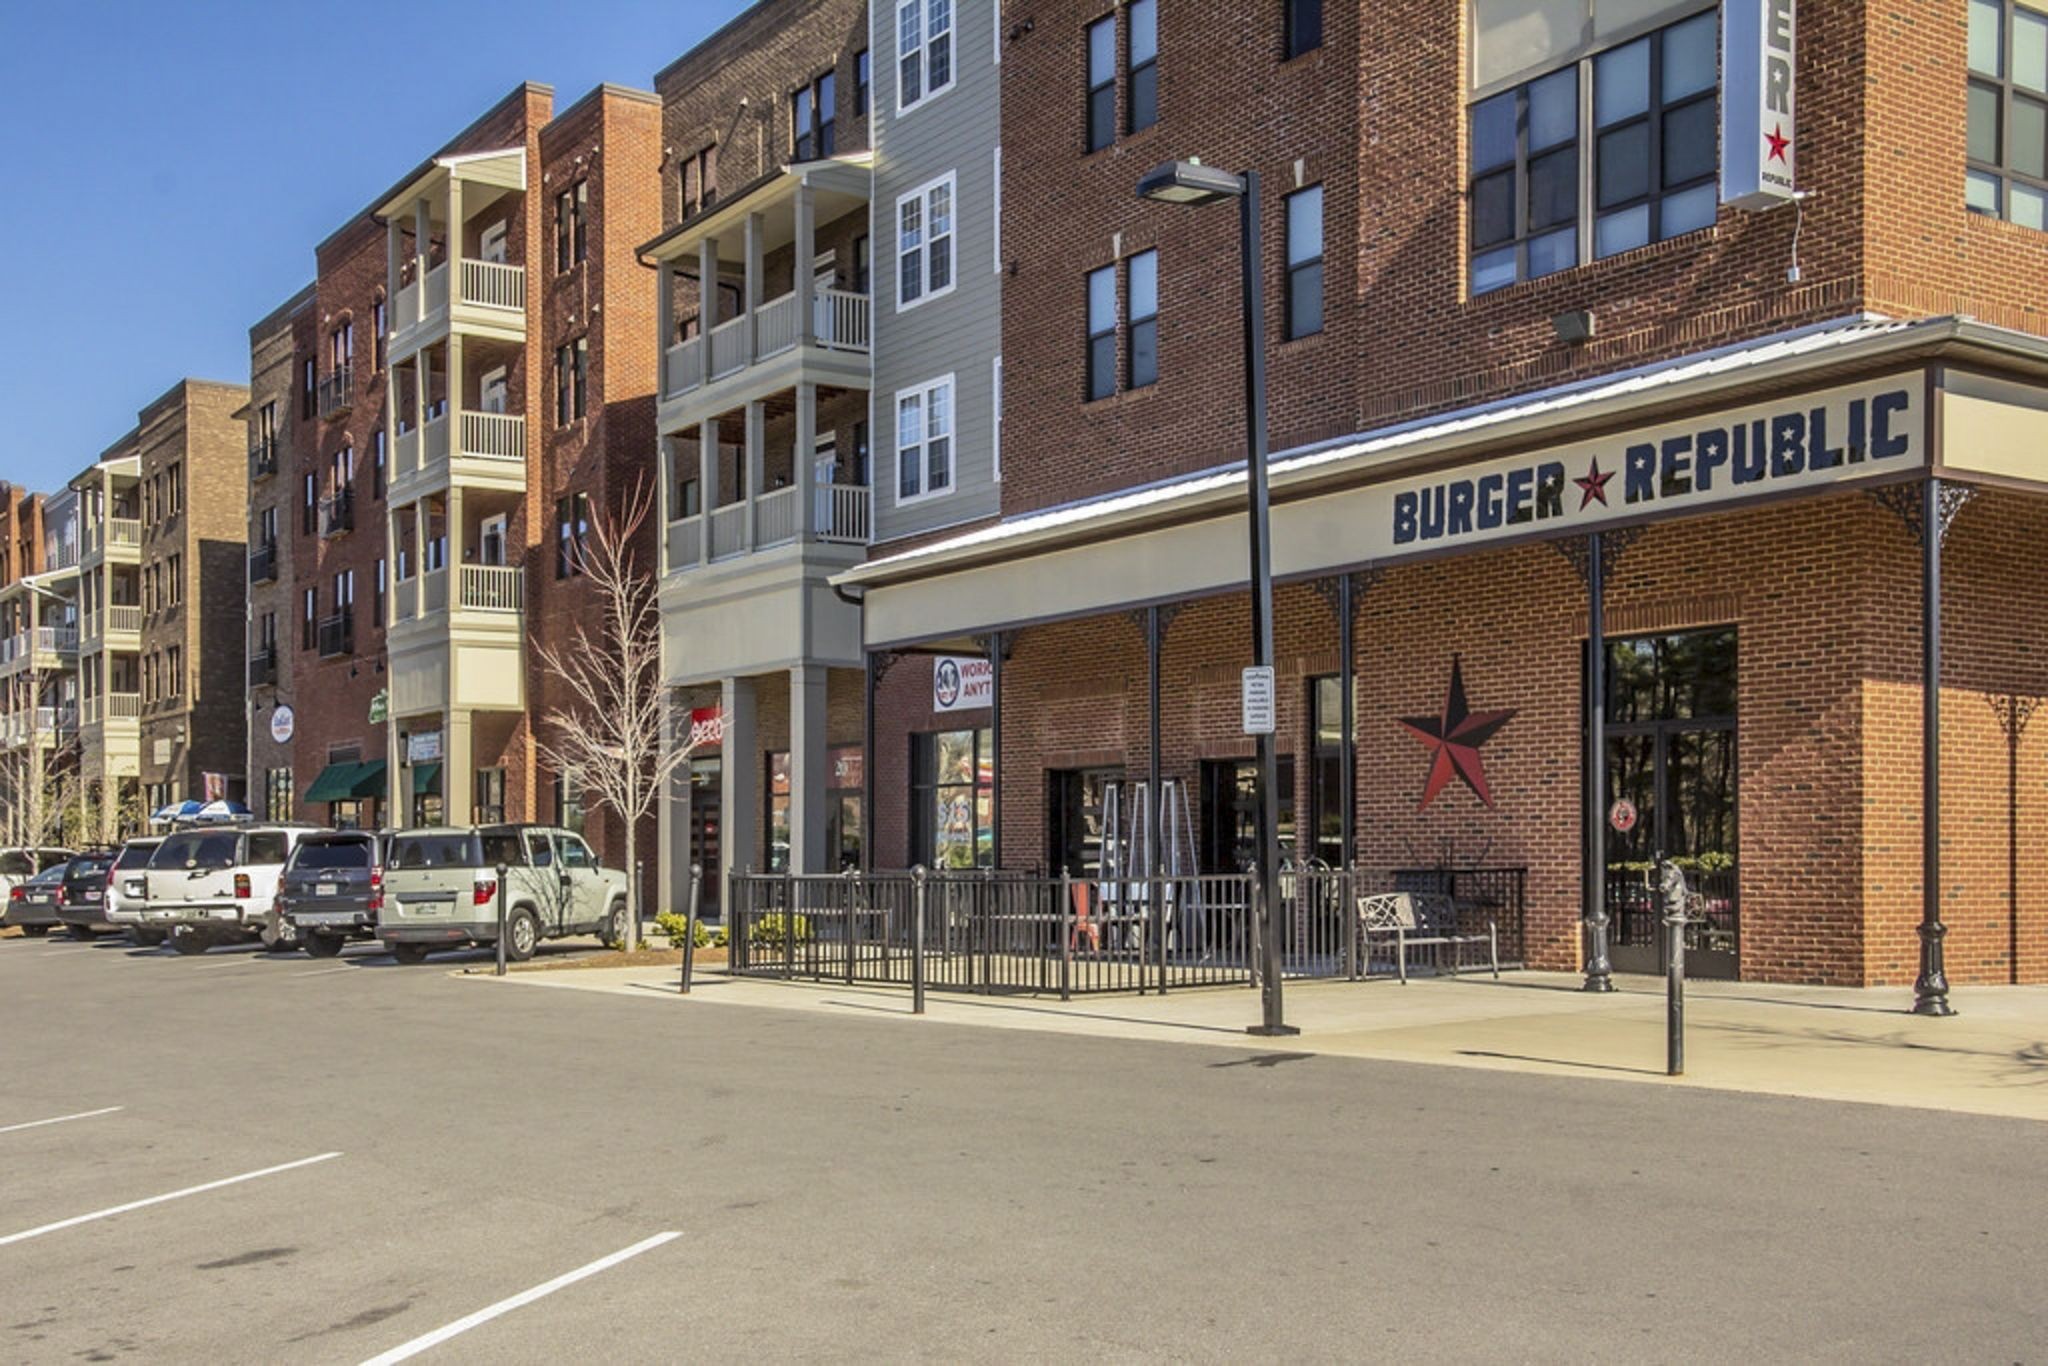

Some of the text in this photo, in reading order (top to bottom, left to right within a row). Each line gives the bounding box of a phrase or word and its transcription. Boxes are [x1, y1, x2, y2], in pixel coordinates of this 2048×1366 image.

[1762, 171, 1792, 188] REPUBLIC
[1393, 390, 1909, 544] BURGER REPUBLIC
